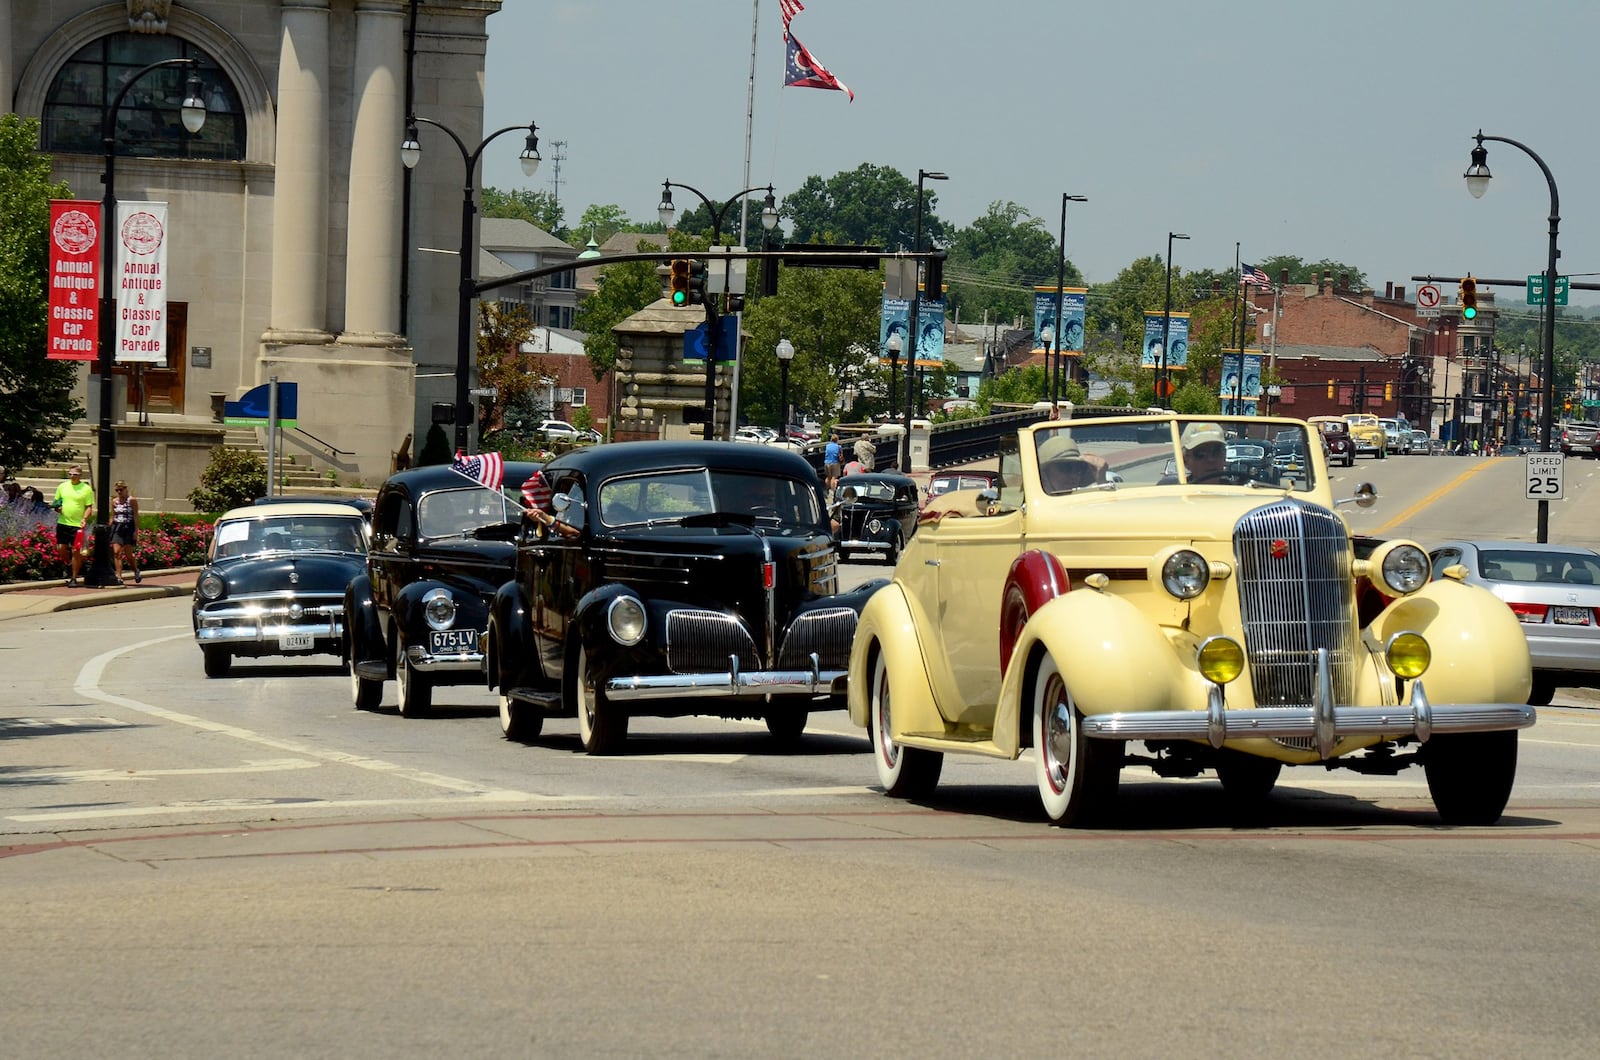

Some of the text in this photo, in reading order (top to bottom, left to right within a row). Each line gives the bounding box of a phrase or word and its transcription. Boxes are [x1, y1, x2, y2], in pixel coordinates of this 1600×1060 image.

[56, 260, 93, 274] Annual
[124, 262, 160, 274] Annual
[53, 275, 95, 290] Antique
[122, 278, 162, 290] Antique
[69, 291, 78, 304] &
[138, 292, 145, 305] &
[53, 306, 94, 320] Classic
[122, 308, 161, 320] Classic
[63, 322, 83, 335] Car
[131, 323, 151, 336] Car
[53, 337, 92, 351] Parade
[122, 339, 160, 351] Parade
[1529, 457, 1561, 465] SPEED
[1532, 467, 1557, 475] LIMIT
[1528, 477, 1559, 494] 25
